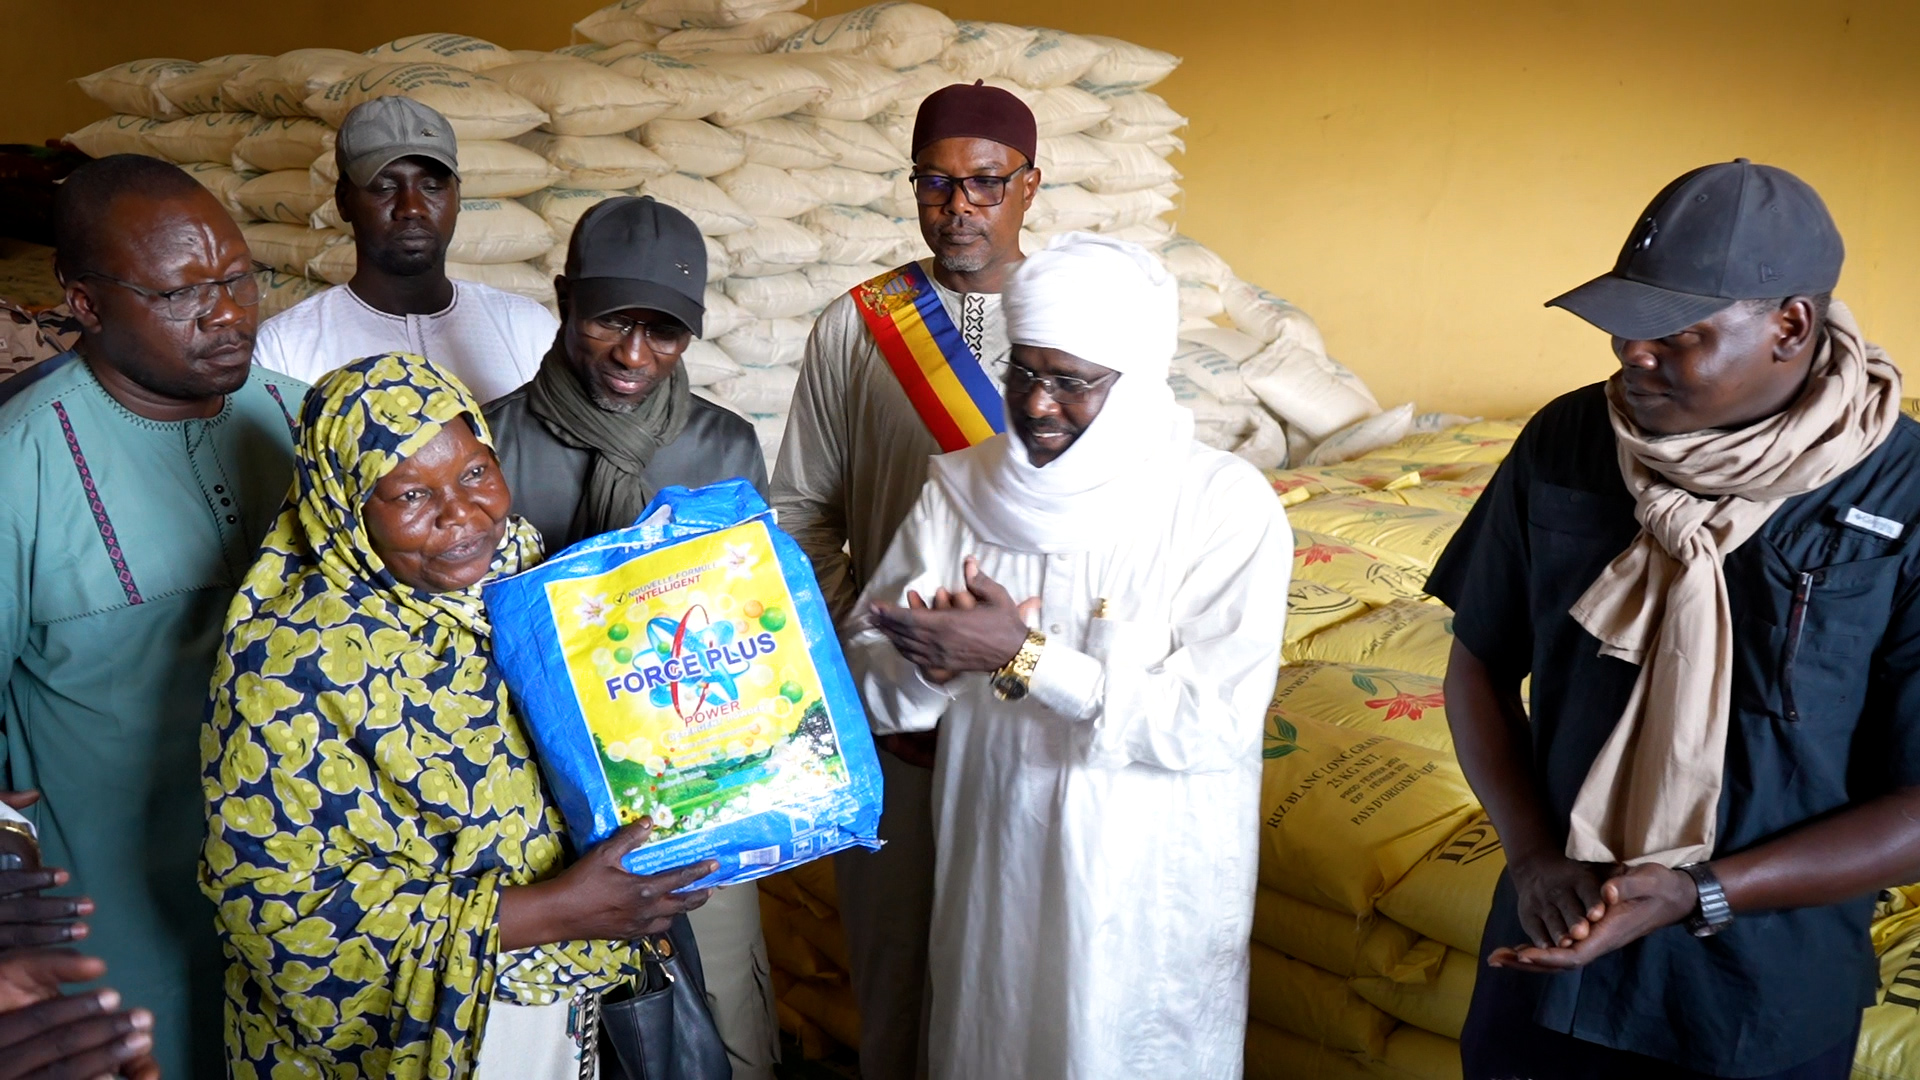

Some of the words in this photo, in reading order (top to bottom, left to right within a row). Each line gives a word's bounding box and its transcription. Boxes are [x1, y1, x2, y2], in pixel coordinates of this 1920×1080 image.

[462, 201, 502, 211] WEIGHT
[628, 575, 675, 599] NOUVELLE
[636, 574, 701, 604] INTELLIGENT
[606, 654, 701, 700] FORCE
[706, 633, 776, 670] PLUS
[684, 701, 741, 728] POWER
[1266, 805, 1290, 829] RIZ
[1285, 770, 1325, 805] BLANC
[1320, 751, 1354, 775] LONG
[1326, 778, 1343, 789] 25
[1339, 767, 1360, 780] KG
[1350, 805, 1376, 826] PAYS
